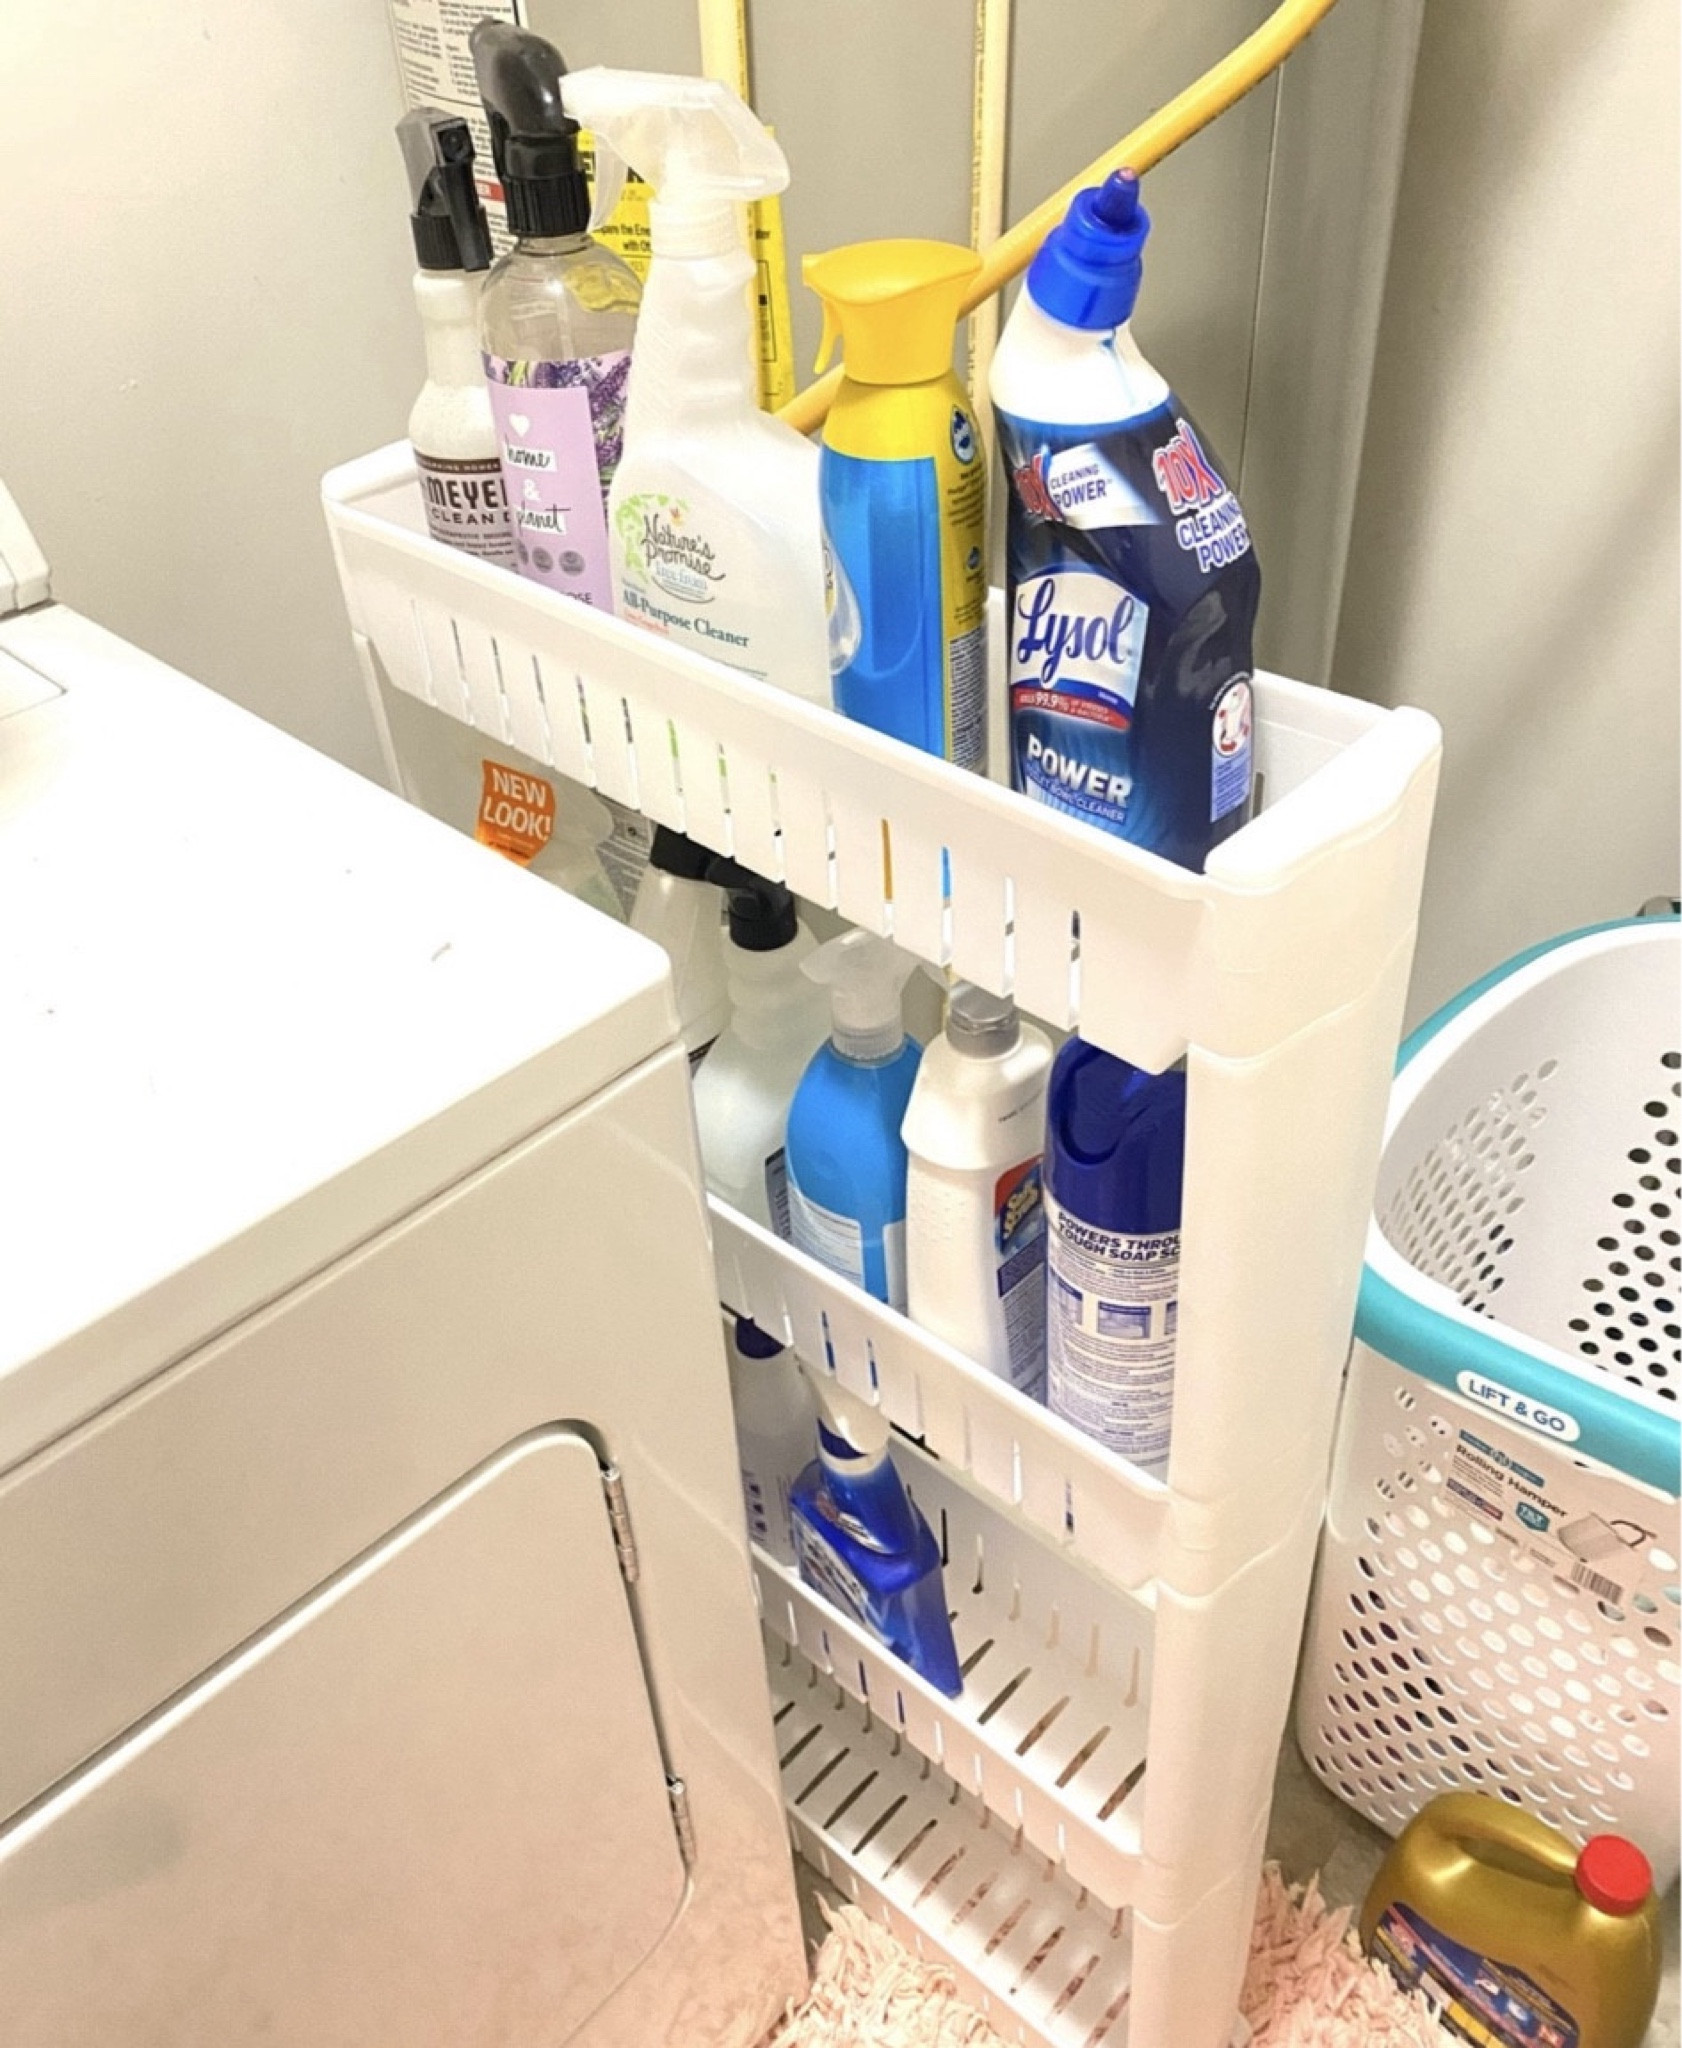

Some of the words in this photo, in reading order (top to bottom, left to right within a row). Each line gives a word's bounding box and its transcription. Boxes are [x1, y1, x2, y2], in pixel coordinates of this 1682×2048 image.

[504, 434, 550, 468] home
[1156, 422, 1225, 505] 10X
[1051, 464, 1099, 490] CLEANING
[1052, 481, 1107, 508] POWER
[432, 509, 495, 526] CLEAN
[516, 500, 571, 536] planet
[643, 513, 715, 560] Nature's
[641, 538, 726, 581] Promise
[623, 590, 691, 631] All-Purpose
[693, 618, 749, 648] Cleaner
[1017, 578, 1132, 689] Lysol
[1036, 691, 1069, 712] 99.9%
[491, 767, 546, 808] NEW
[1027, 733, 1133, 808] POWER
[482, 797, 551, 841] LOOK!
[1059, 1211, 1121, 1248] POWERS
[1060, 1223, 1105, 1256] TOUGH
[1110, 1249, 1157, 1261] SOAP
[1161, 1247, 1180, 1257] SC
[1467, 1378, 1511, 1408] LIFT
[1515, 1401, 1529, 1417] &
[1533, 1409, 1566, 1433] GO
[1456, 1444, 1504, 1481] Rolling
[1508, 1477, 1567, 1517] Hamper
